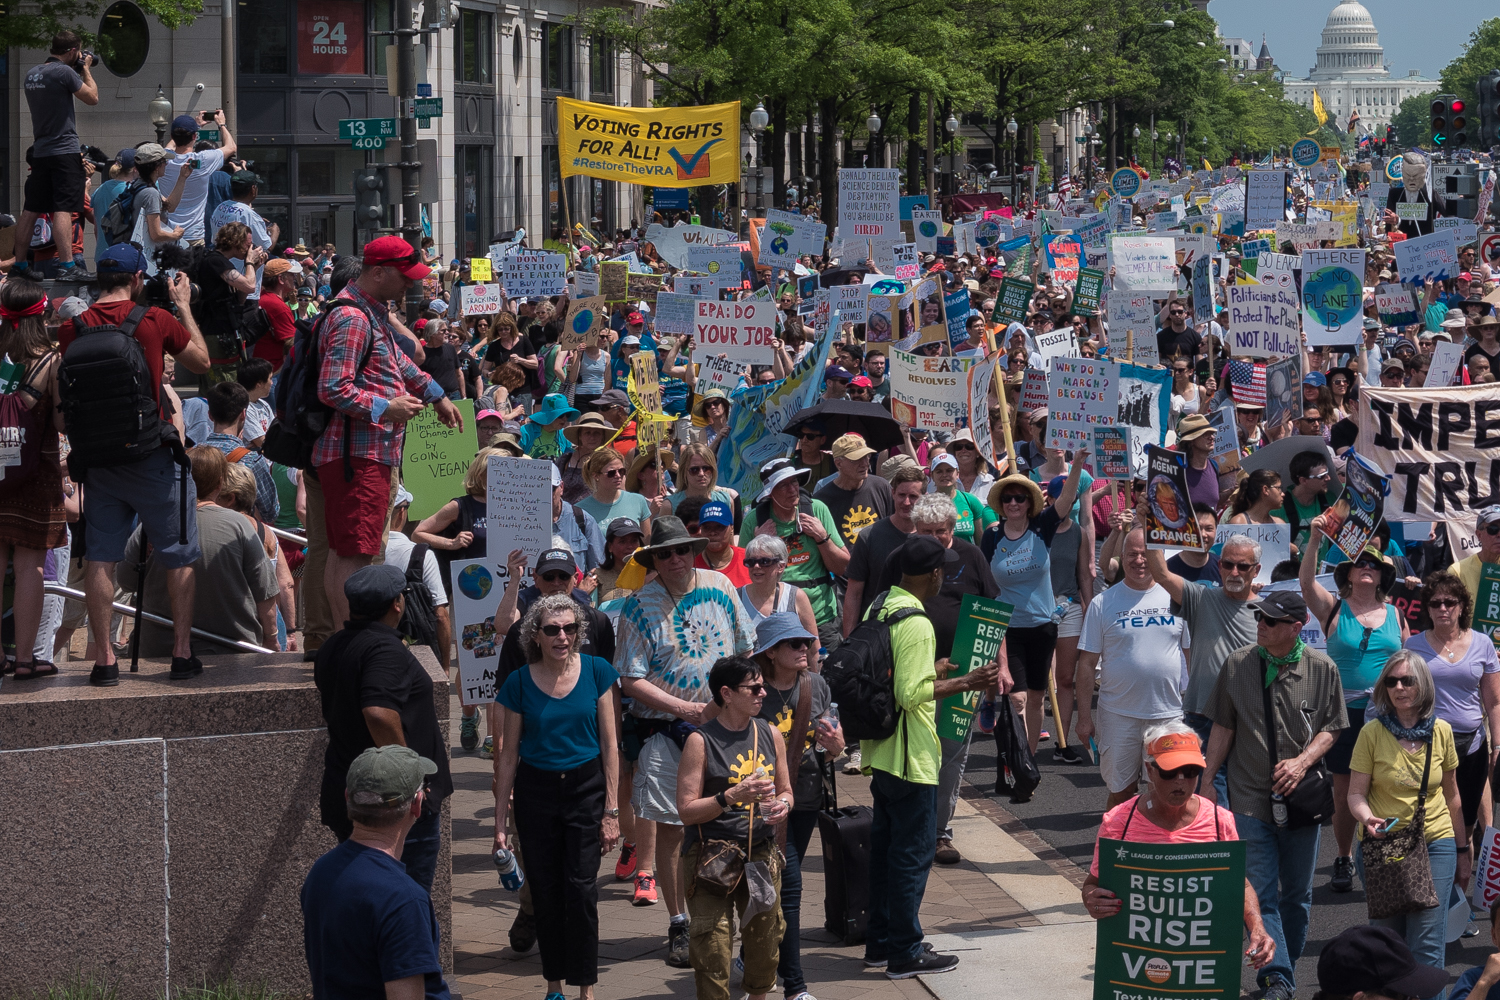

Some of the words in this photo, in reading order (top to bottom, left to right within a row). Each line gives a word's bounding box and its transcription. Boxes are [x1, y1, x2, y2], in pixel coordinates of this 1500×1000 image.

[313, 22, 347, 44] 24
[313, 46, 347, 54] HOURS
[347, 122, 366, 135] 13
[572, 113, 640, 137] VOTING
[647, 121, 723, 141] RIGHTS
[355, 138, 382, 148] 400
[578, 139, 612, 155] FOR
[618, 141, 660, 161] ALL!
[572, 157, 674, 176] #RestoreTheVRA
[841, 172, 866, 180] DONALD
[868, 172, 880, 180] THE
[882, 172, 897, 180] LIAR
[842, 182, 870, 190] SCIENCE
[872, 182, 895, 190] DENIER
[848, 192, 889, 200] DESTROYING
[861, 202, 891, 211] PLANET?
[858, 213, 884, 221] SHOULD
[886, 213, 894, 221] BE
[854, 224, 883, 235] FIRED!
[1308, 251, 1360, 265] THERE
[1306, 272, 1322, 282] IS
[1331, 270, 1352, 283] NO
[841, 288, 859, 299] STOP
[837, 300, 865, 311] CLIMATE
[1304, 293, 1361, 309] PLANET
[468, 303, 497, 313] AROUND
[699, 302, 730, 319] EPA:
[734, 304, 755, 319] DO
[1324, 314, 1341, 333] B
[698, 324, 737, 344] YOUR
[743, 326, 775, 347] JOB
[410, 451, 447, 463] GOING
[428, 461, 470, 478] VEGAN
[1151, 462, 1179, 475] AGENT
[1150, 530, 1198, 544] ORANGE
[1130, 852, 1159, 860] LEAGUE
[1130, 874, 1213, 893] RESIST
[1129, 893, 1213, 917] BUILD
[1128, 914, 1212, 946] RISE
